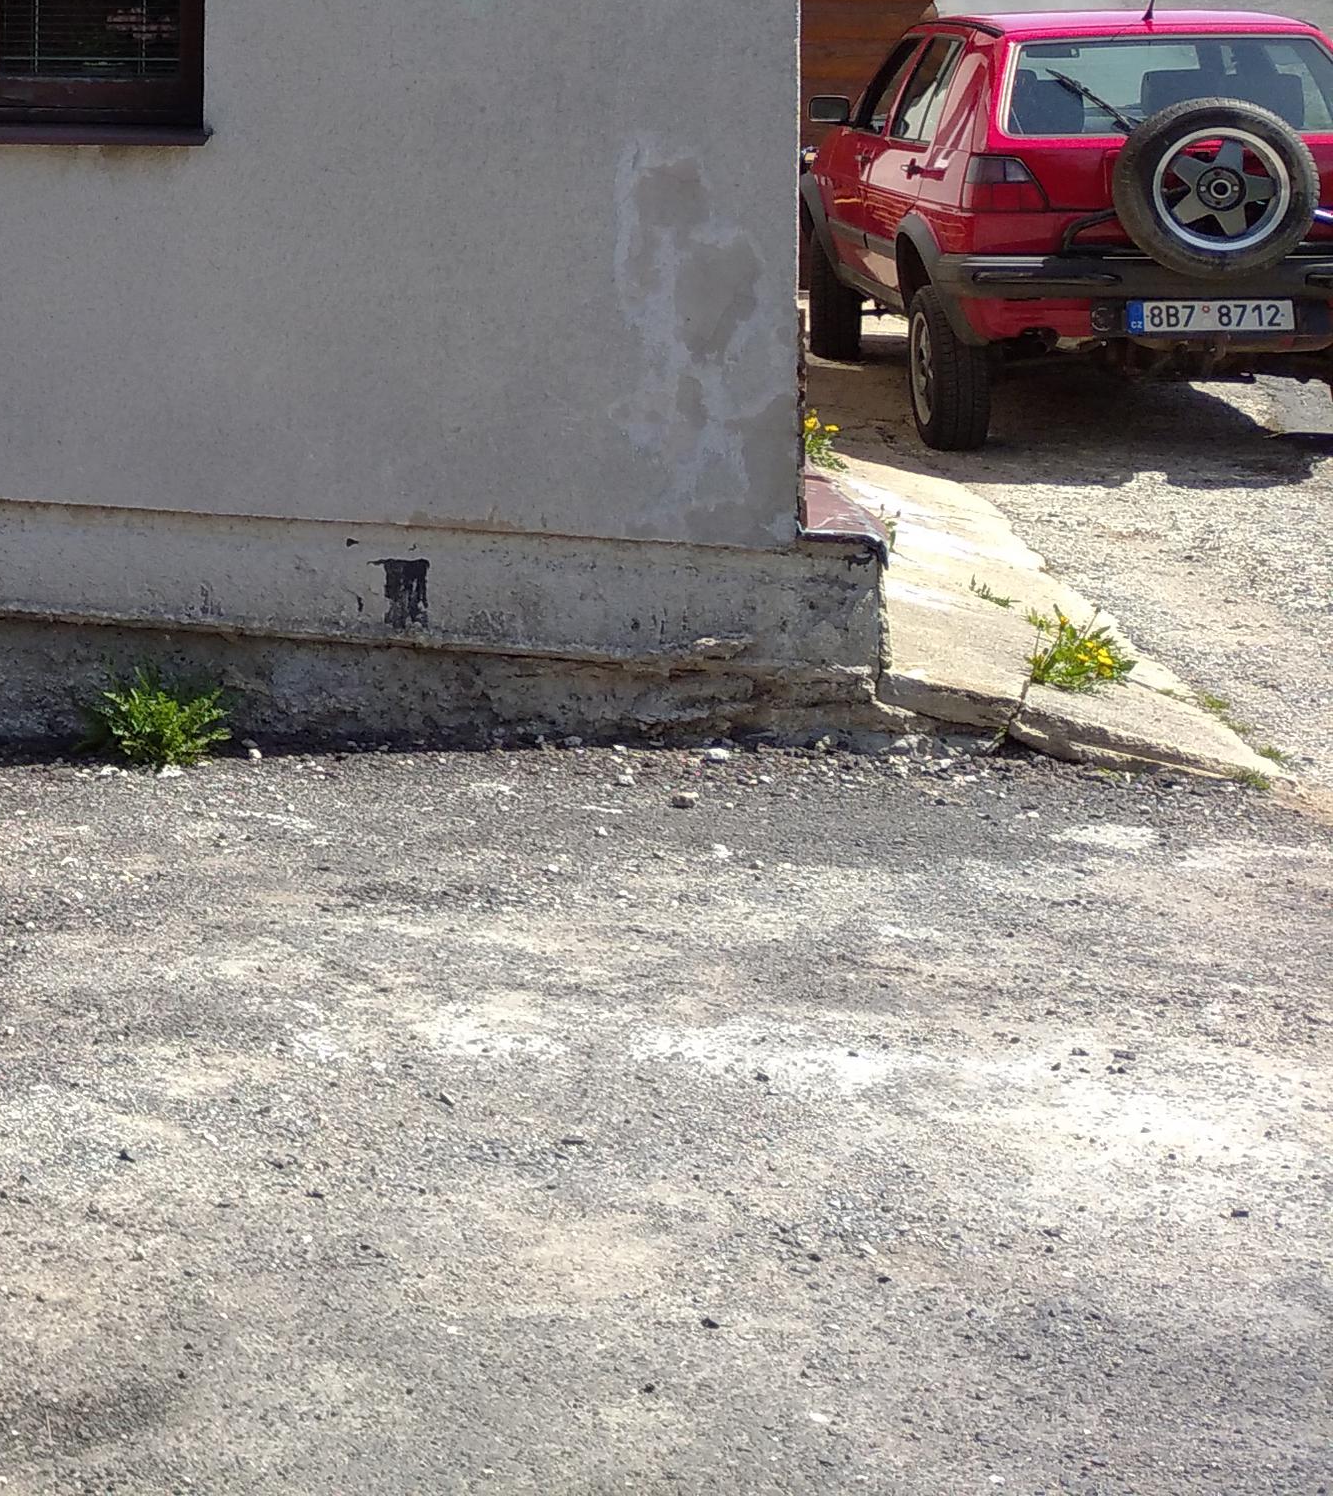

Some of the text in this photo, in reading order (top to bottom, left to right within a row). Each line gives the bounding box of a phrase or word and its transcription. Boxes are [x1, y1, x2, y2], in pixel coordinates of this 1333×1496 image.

[1149, 304, 1282, 328] 8B7 8712
[1130, 321, 1143, 330] CZ
